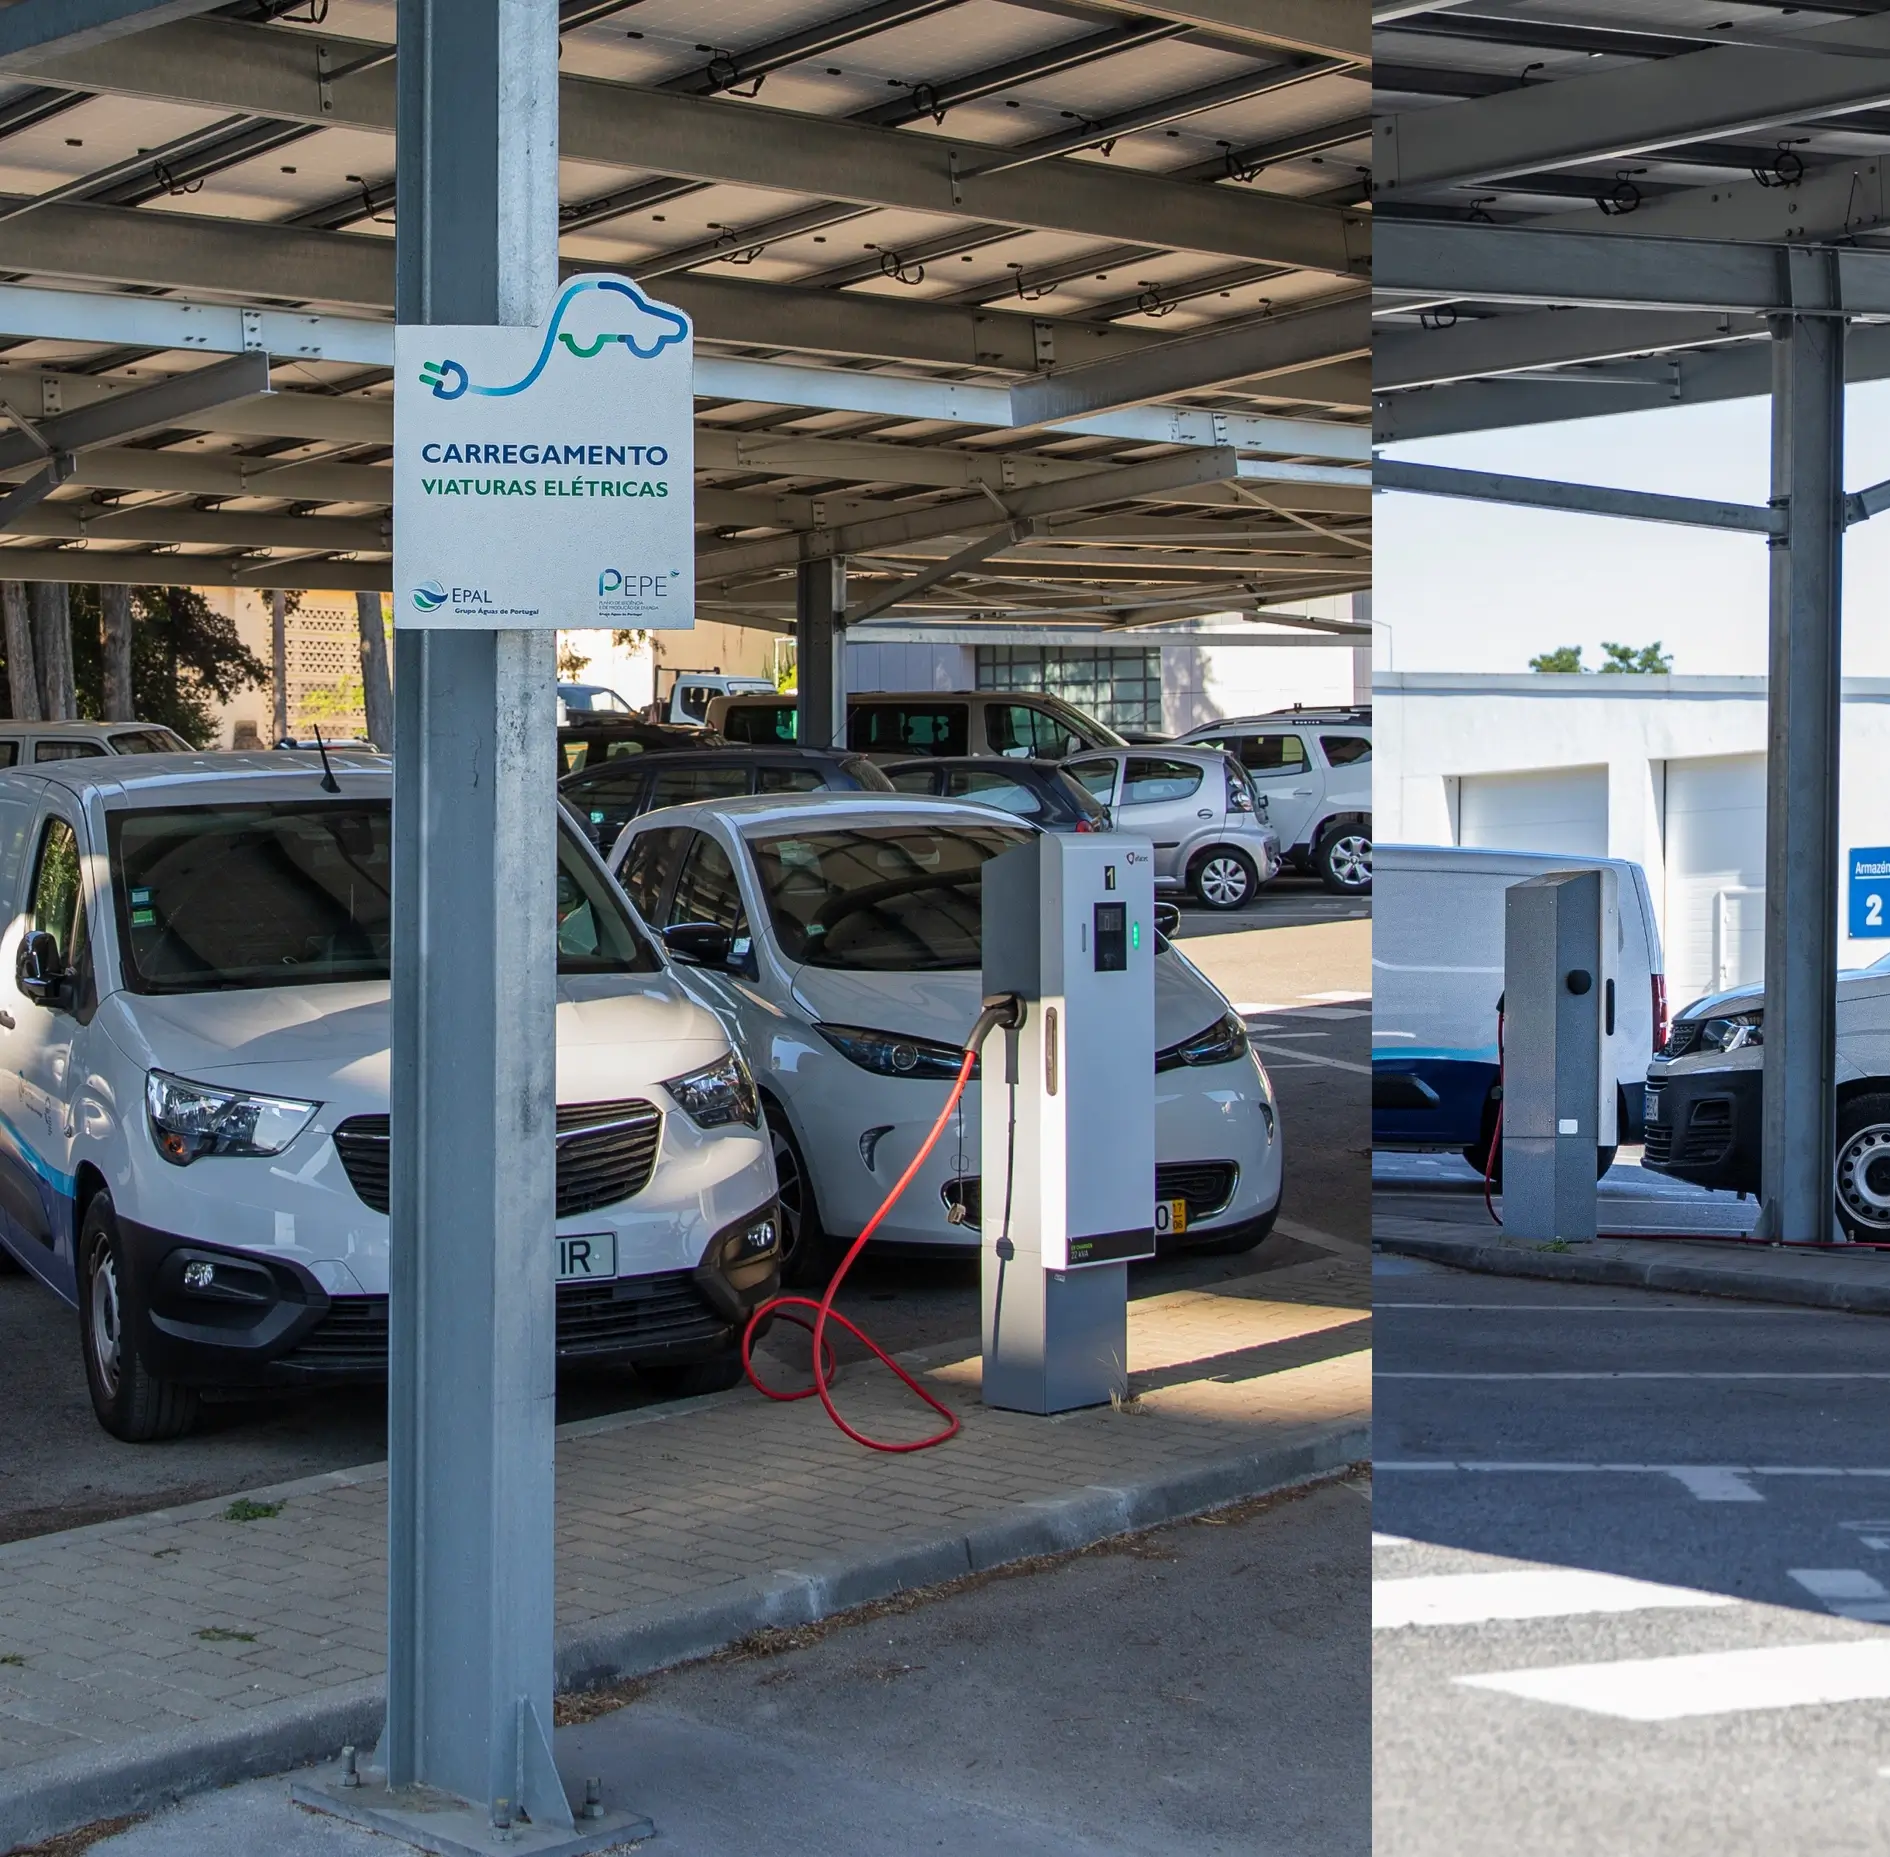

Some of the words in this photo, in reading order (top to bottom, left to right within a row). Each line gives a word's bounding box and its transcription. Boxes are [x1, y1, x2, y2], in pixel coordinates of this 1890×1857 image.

[421, 443, 669, 466] CARREGAMENTO
[421, 478, 537, 496] VIATURAS
[544, 475, 669, 498] ELÉTRICAS
[452, 588, 493, 603] EPAL
[478, 607, 498, 616] Águas
[510, 608, 539, 616] Portugal
[1106, 867, 1114, 889] 1
[1865, 894, 1882, 926] 2
[1172, 1219, 1183, 1230] 06
[560, 1240, 591, 1275] IR
